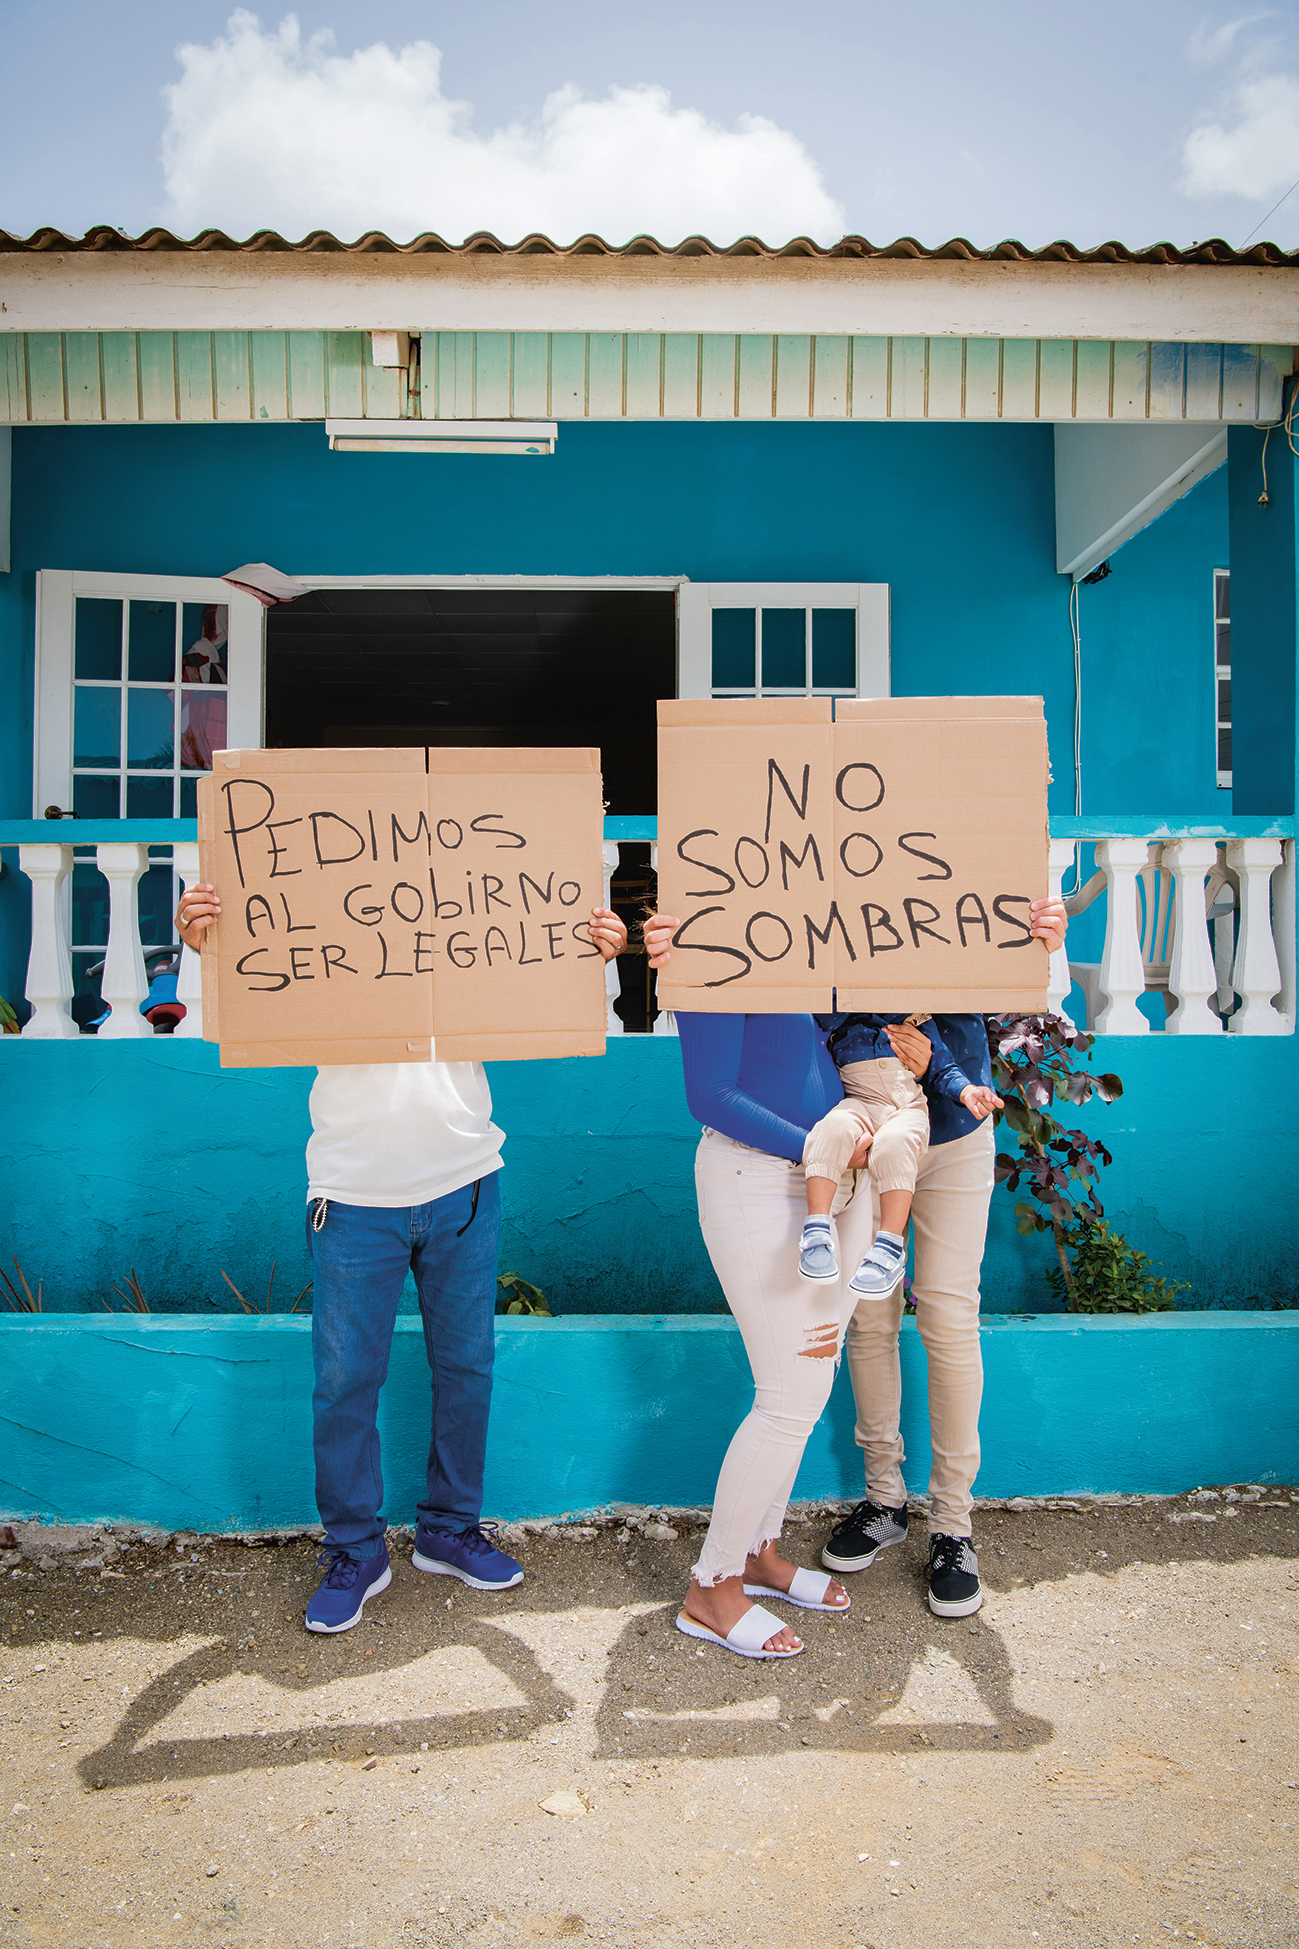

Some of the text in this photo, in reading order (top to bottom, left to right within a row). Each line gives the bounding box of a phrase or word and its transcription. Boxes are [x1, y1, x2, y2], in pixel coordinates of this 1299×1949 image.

[221, 779, 527, 888] PEDIMOS
[765, 758, 885, 844] NO
[677, 829, 953, 897] SOMOS
[245, 893, 316, 938] AL
[671, 893, 1035, 987] SOMBRAS
[236, 921, 601, 991] SER LEGALES
